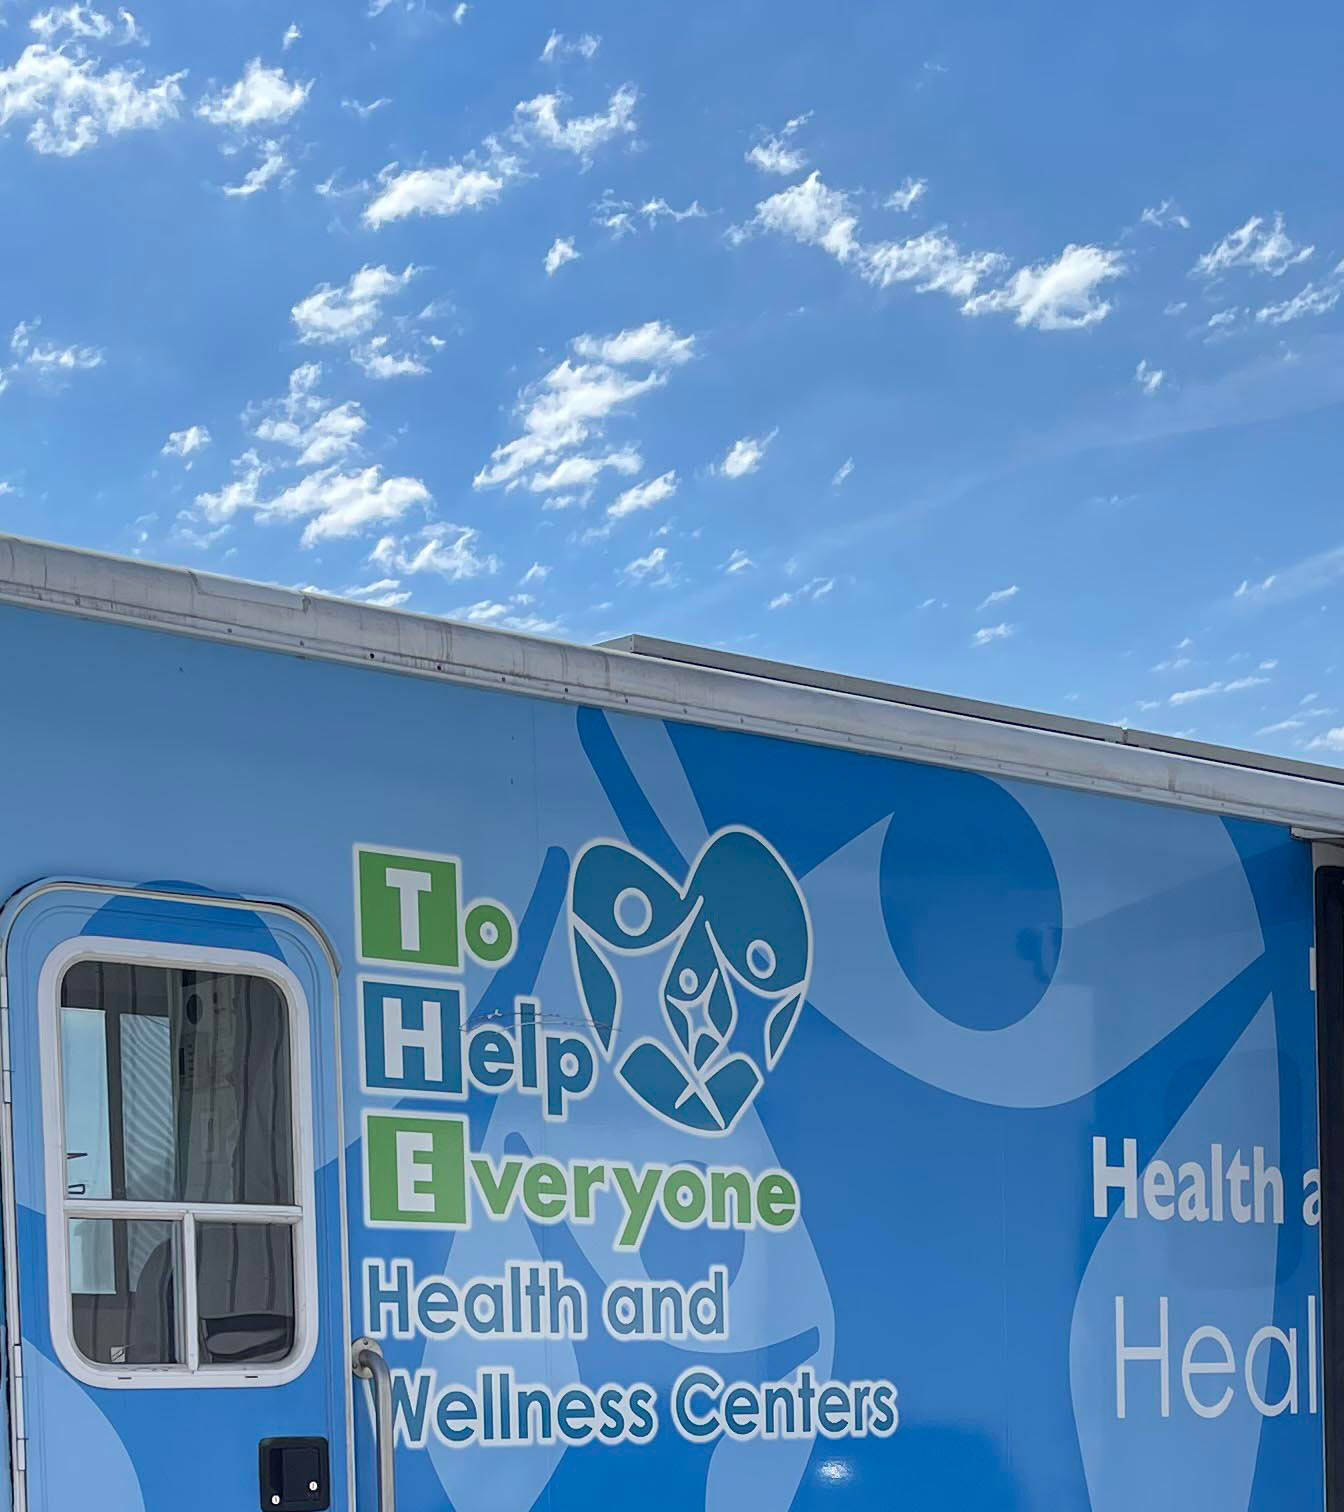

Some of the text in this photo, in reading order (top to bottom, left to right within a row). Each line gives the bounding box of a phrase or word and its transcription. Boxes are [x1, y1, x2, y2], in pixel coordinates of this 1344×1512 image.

[384, 863, 517, 967] To
[382, 994, 599, 1122] Help
[394, 1129, 801, 1252] Everyone
[1092, 1135, 1285, 1225] Health
[363, 1258, 728, 1341] Health and
[363, 1364, 899, 1449] Wellness Centers
[1115, 1295, 1318, 1419] Heal
